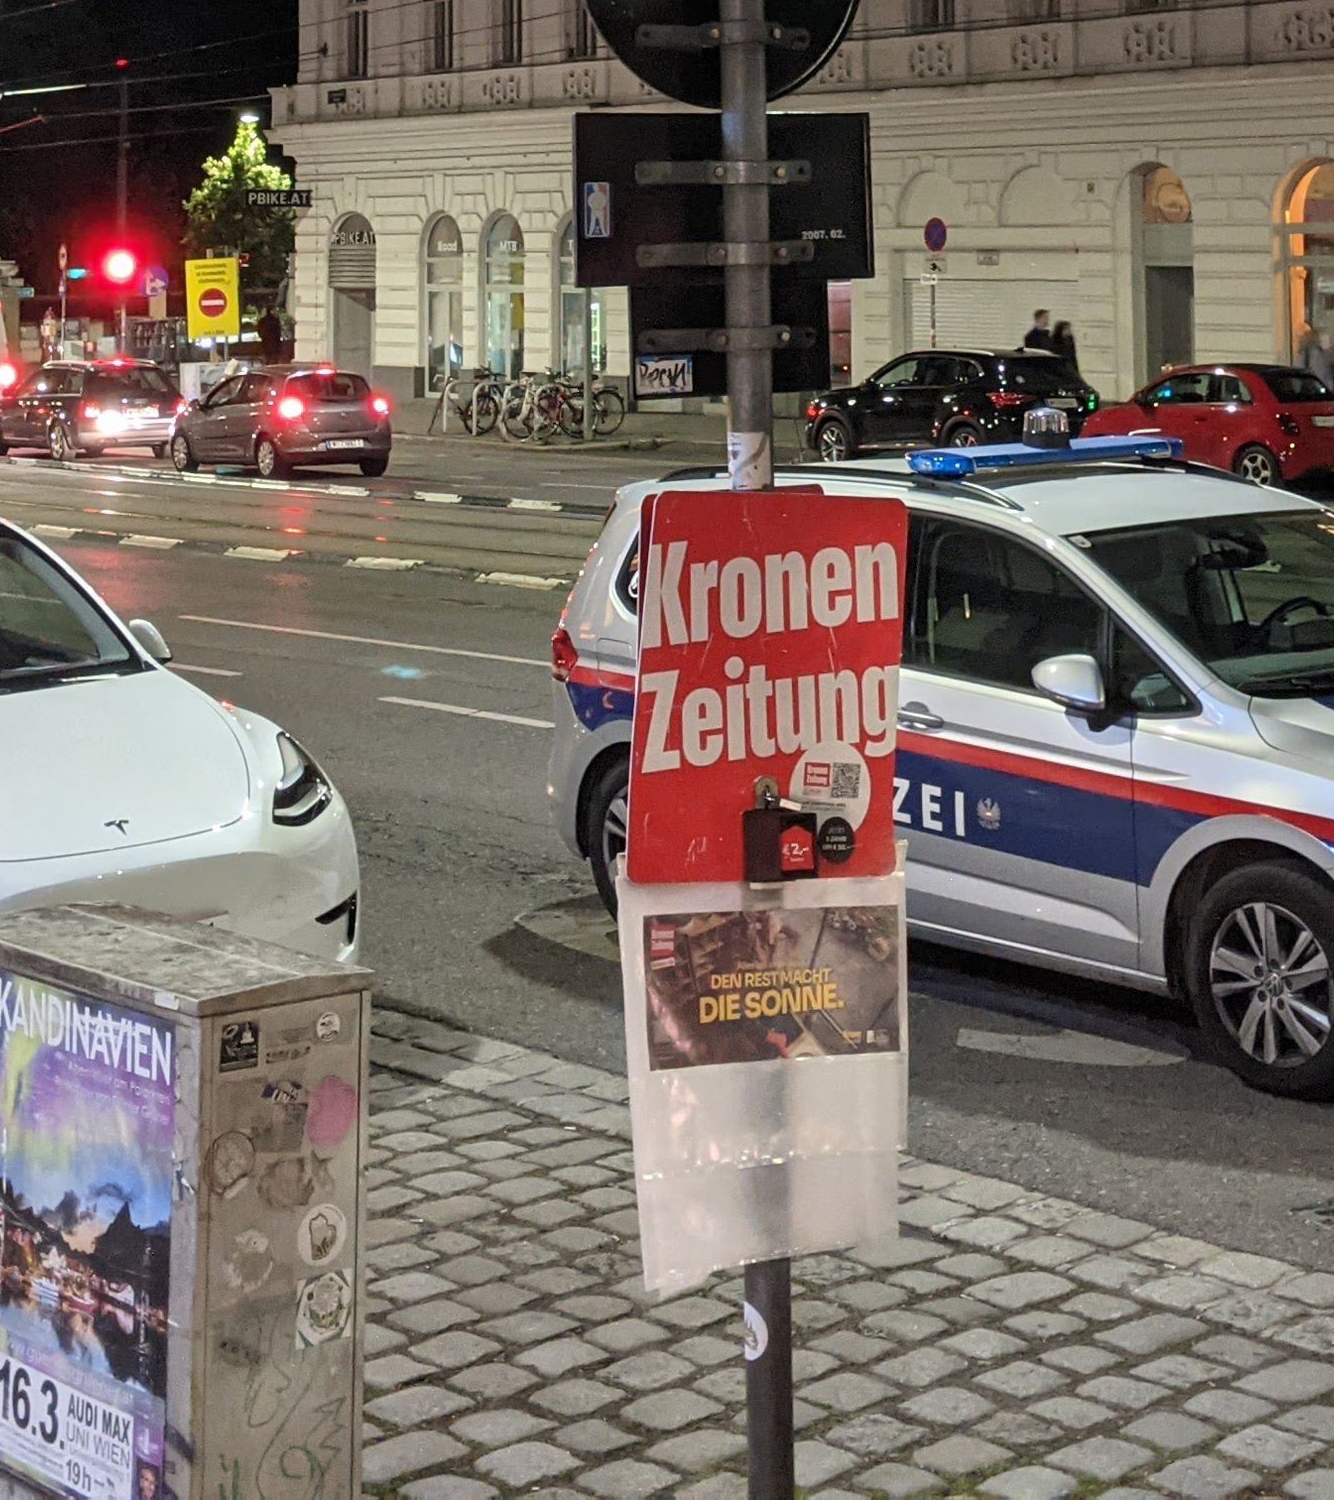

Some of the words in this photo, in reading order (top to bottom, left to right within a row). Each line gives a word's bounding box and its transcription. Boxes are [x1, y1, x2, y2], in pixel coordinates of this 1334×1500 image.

[641, 541, 899, 650] Kronen
[640, 655, 900, 774] Zeitung
[892, 776, 966, 838] ZEI
[699, 993, 742, 1025] DIE
[744, 981, 846, 1020] SONNE.
[710, 973, 743, 990] DEN
[744, 970, 779, 988] REST
[780, 968, 833, 986] MACHT
[66, 1420, 90, 1449] UNI
[93, 1432, 131, 1470] WIEN
[67, 1393, 98, 1431] AUDI
[102, 1409, 131, 1447] MAX
